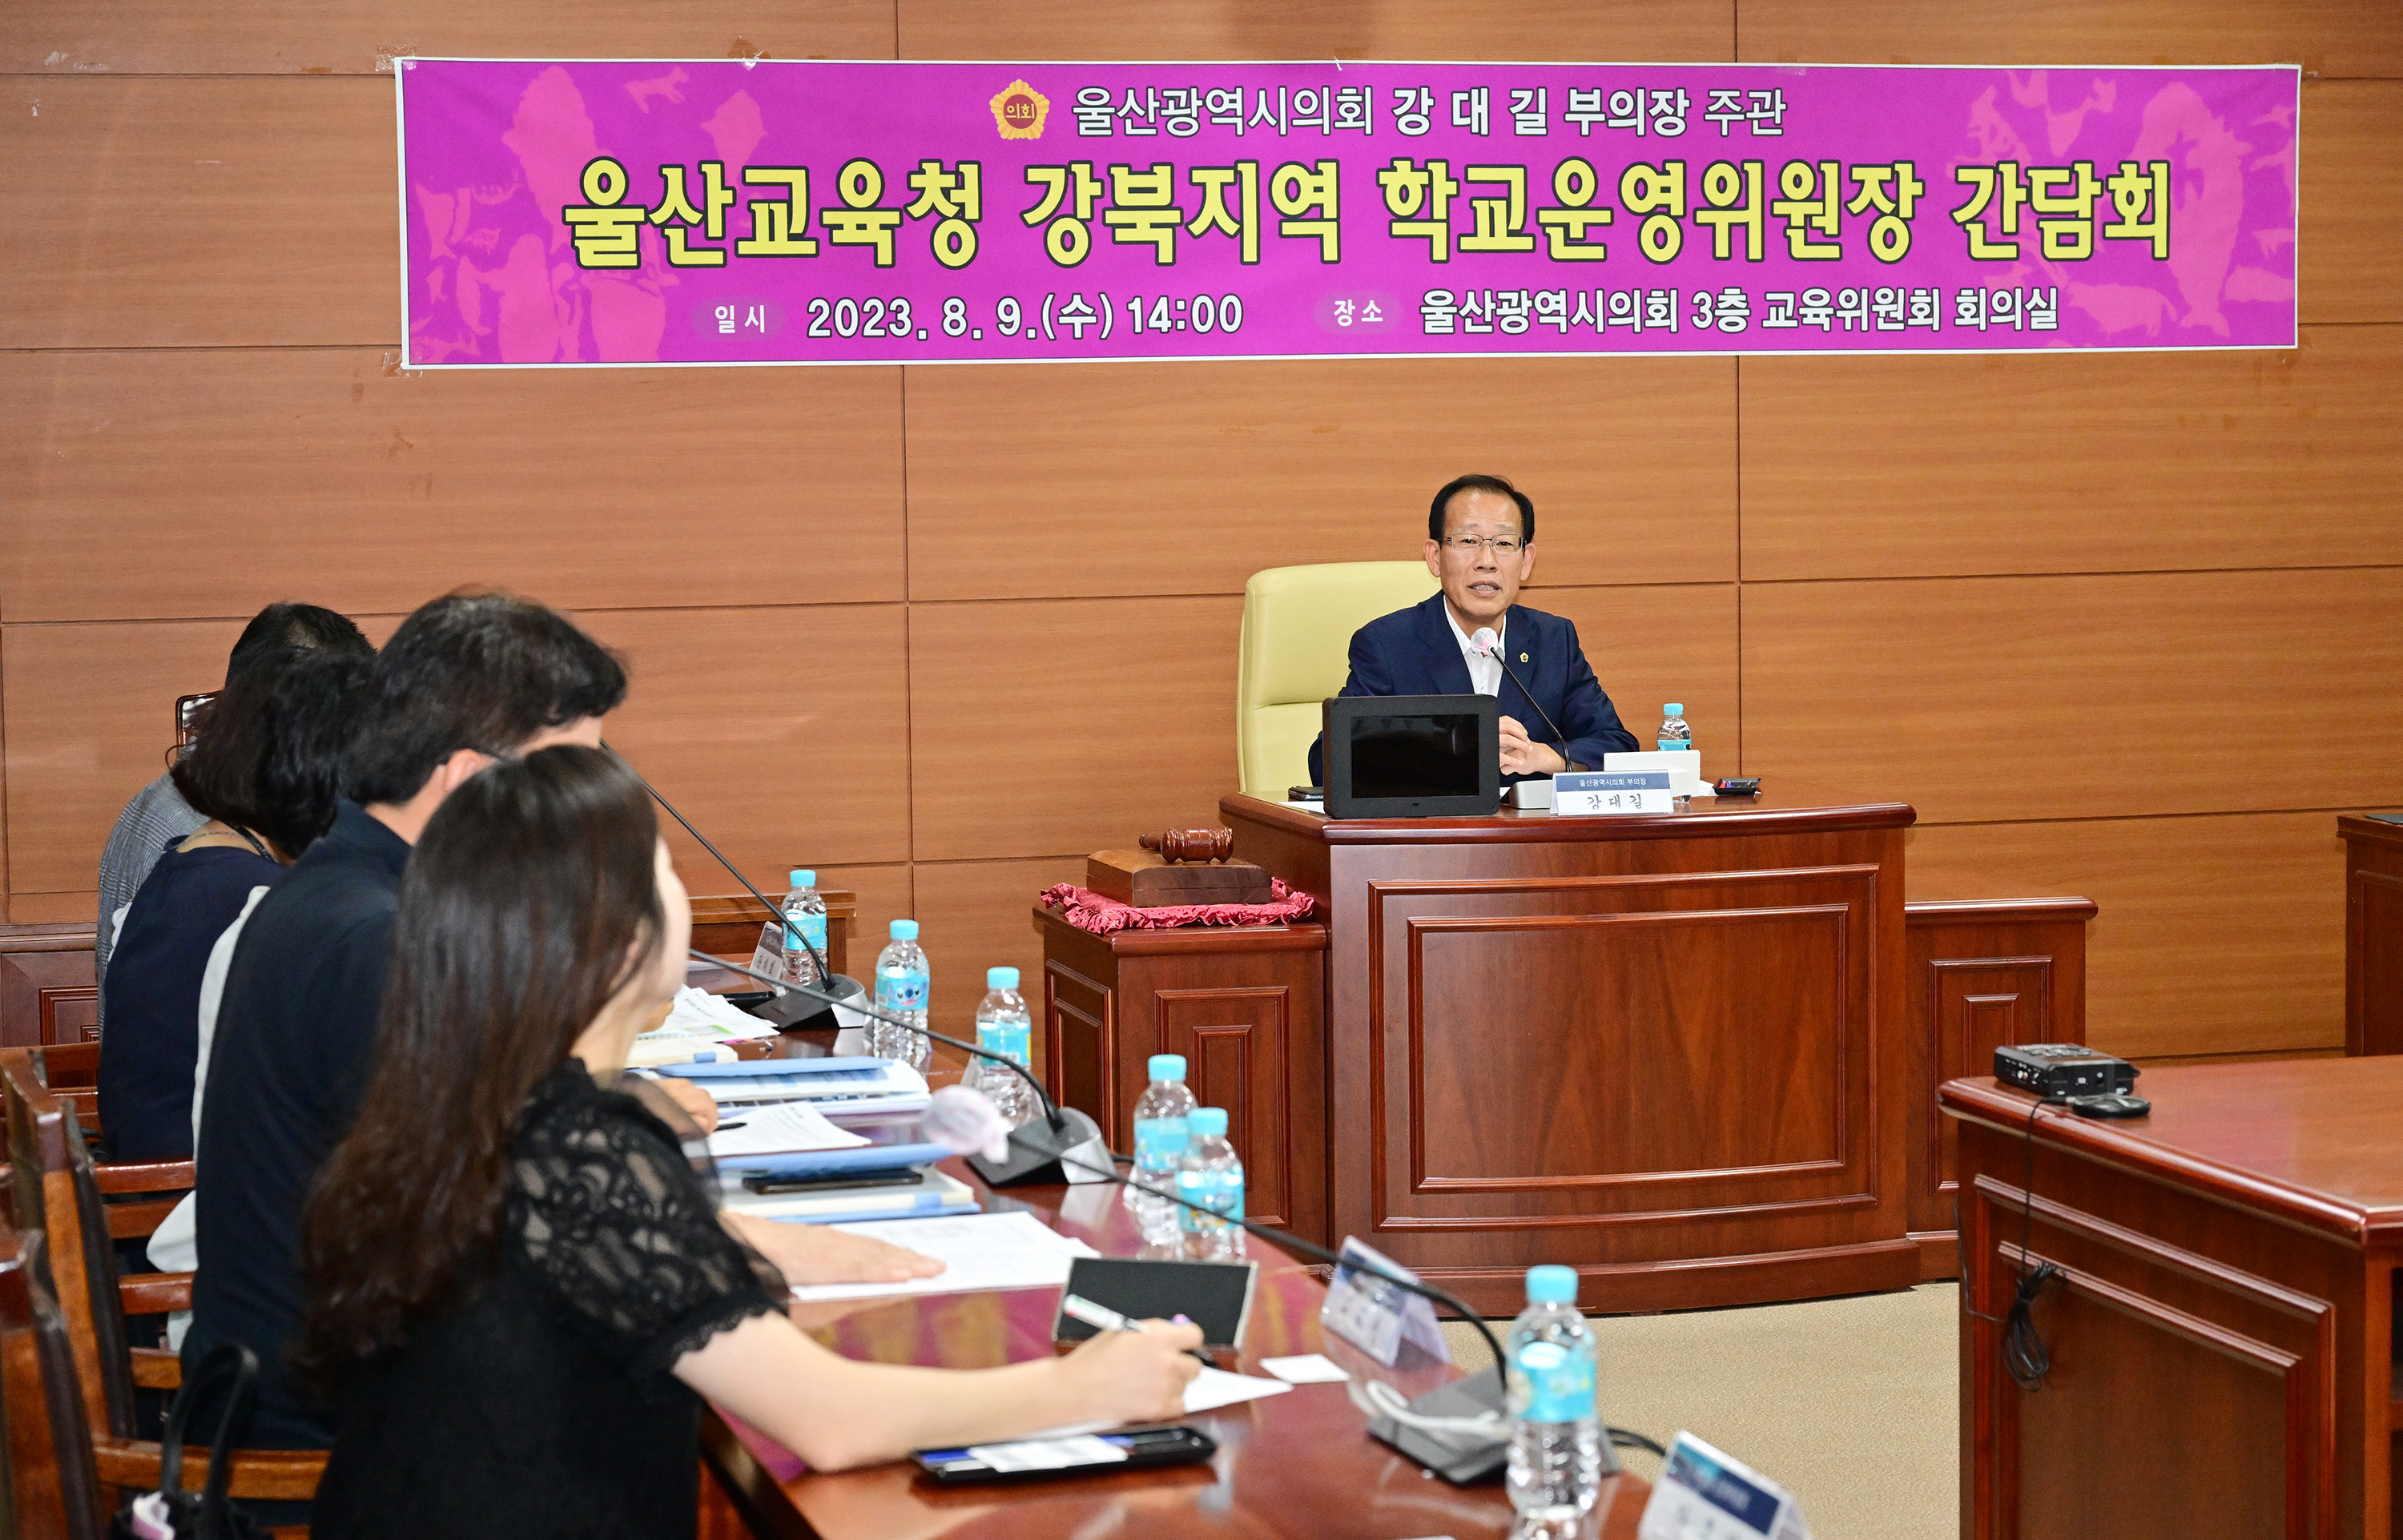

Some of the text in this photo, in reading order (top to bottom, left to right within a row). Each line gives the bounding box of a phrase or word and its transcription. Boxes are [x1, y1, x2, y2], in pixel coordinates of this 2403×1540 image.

[1005, 103, 1036, 119] 의회
[1073, 86, 1787, 137] 울산광역시의회 강 대 길 부의장 주관
[562, 156, 2171, 271] 울산교육청 강북지역 학교운영위원장 간담회
[807, 296, 928, 340] 2023.
[942, 296, 983, 340] 8.
[1126, 293, 1242, 335] 14:00
[1420, 286, 2059, 335] 울산광역시의회 3층 교육위원회 회의실
[1579, 778, 1647, 787] 울산광역시의회 부의장
